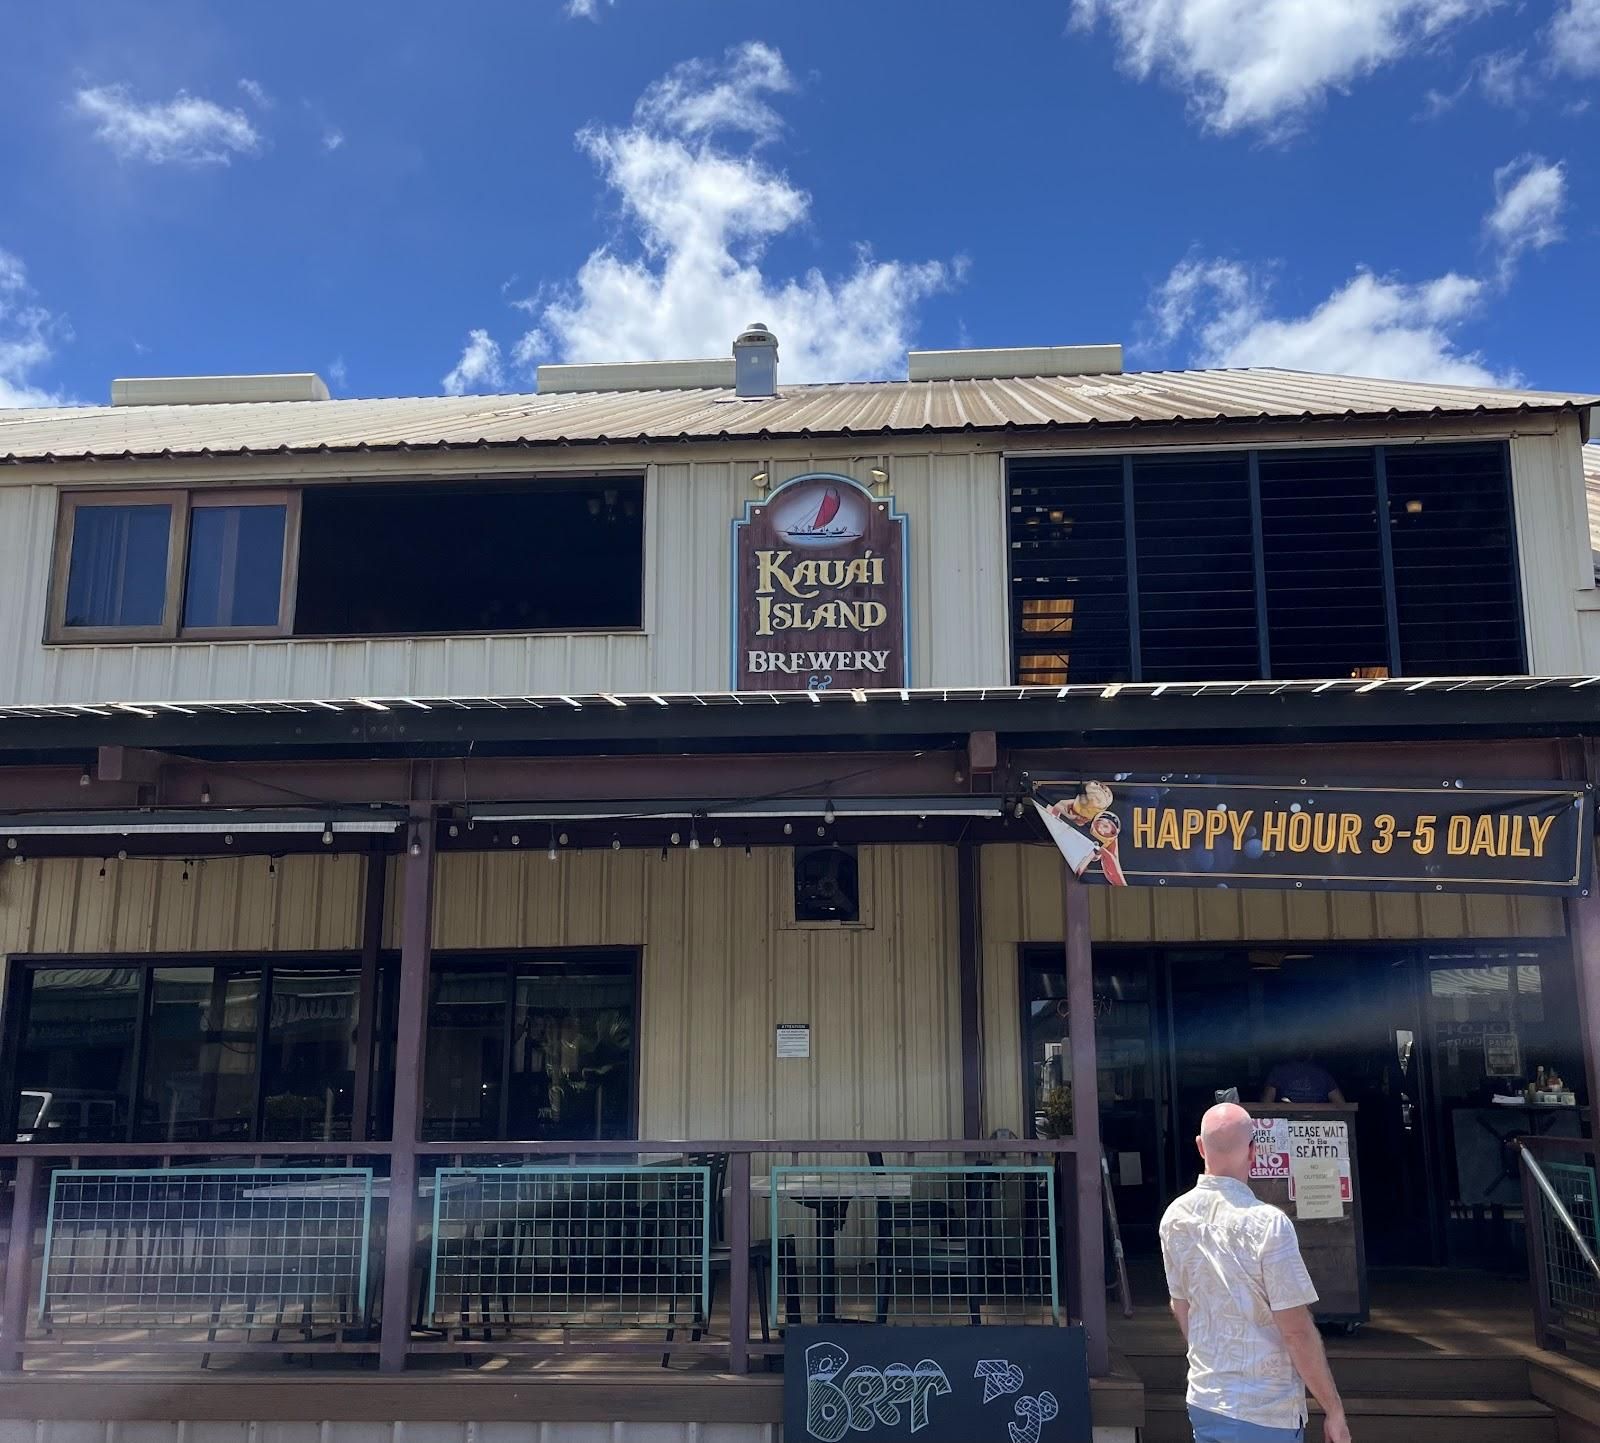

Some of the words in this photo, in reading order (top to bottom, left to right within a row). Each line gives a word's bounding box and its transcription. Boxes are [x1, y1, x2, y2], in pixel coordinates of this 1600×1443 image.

[755, 596, 887, 636] ISLAND
[748, 650, 891, 674] BREWERY
[1133, 807, 1254, 850] HAPPY
[1262, 811, 1362, 854] HOUR
[1371, 813, 1437, 855] 3-5
[1446, 814, 1556, 857] DAILY
[1252, 1129, 1271, 1137] HIRT
[1288, 1126, 1320, 1137] PLEASE
[1322, 1126, 1345, 1137] WAIT
[1253, 1135, 1276, 1143] HOES
[1296, 1145, 1338, 1158] SEATED
[1255, 1153, 1283, 1168] NO
[1251, 1167, 1289, 1176] SERVICE
[805, 1341, 952, 1443] Beer
